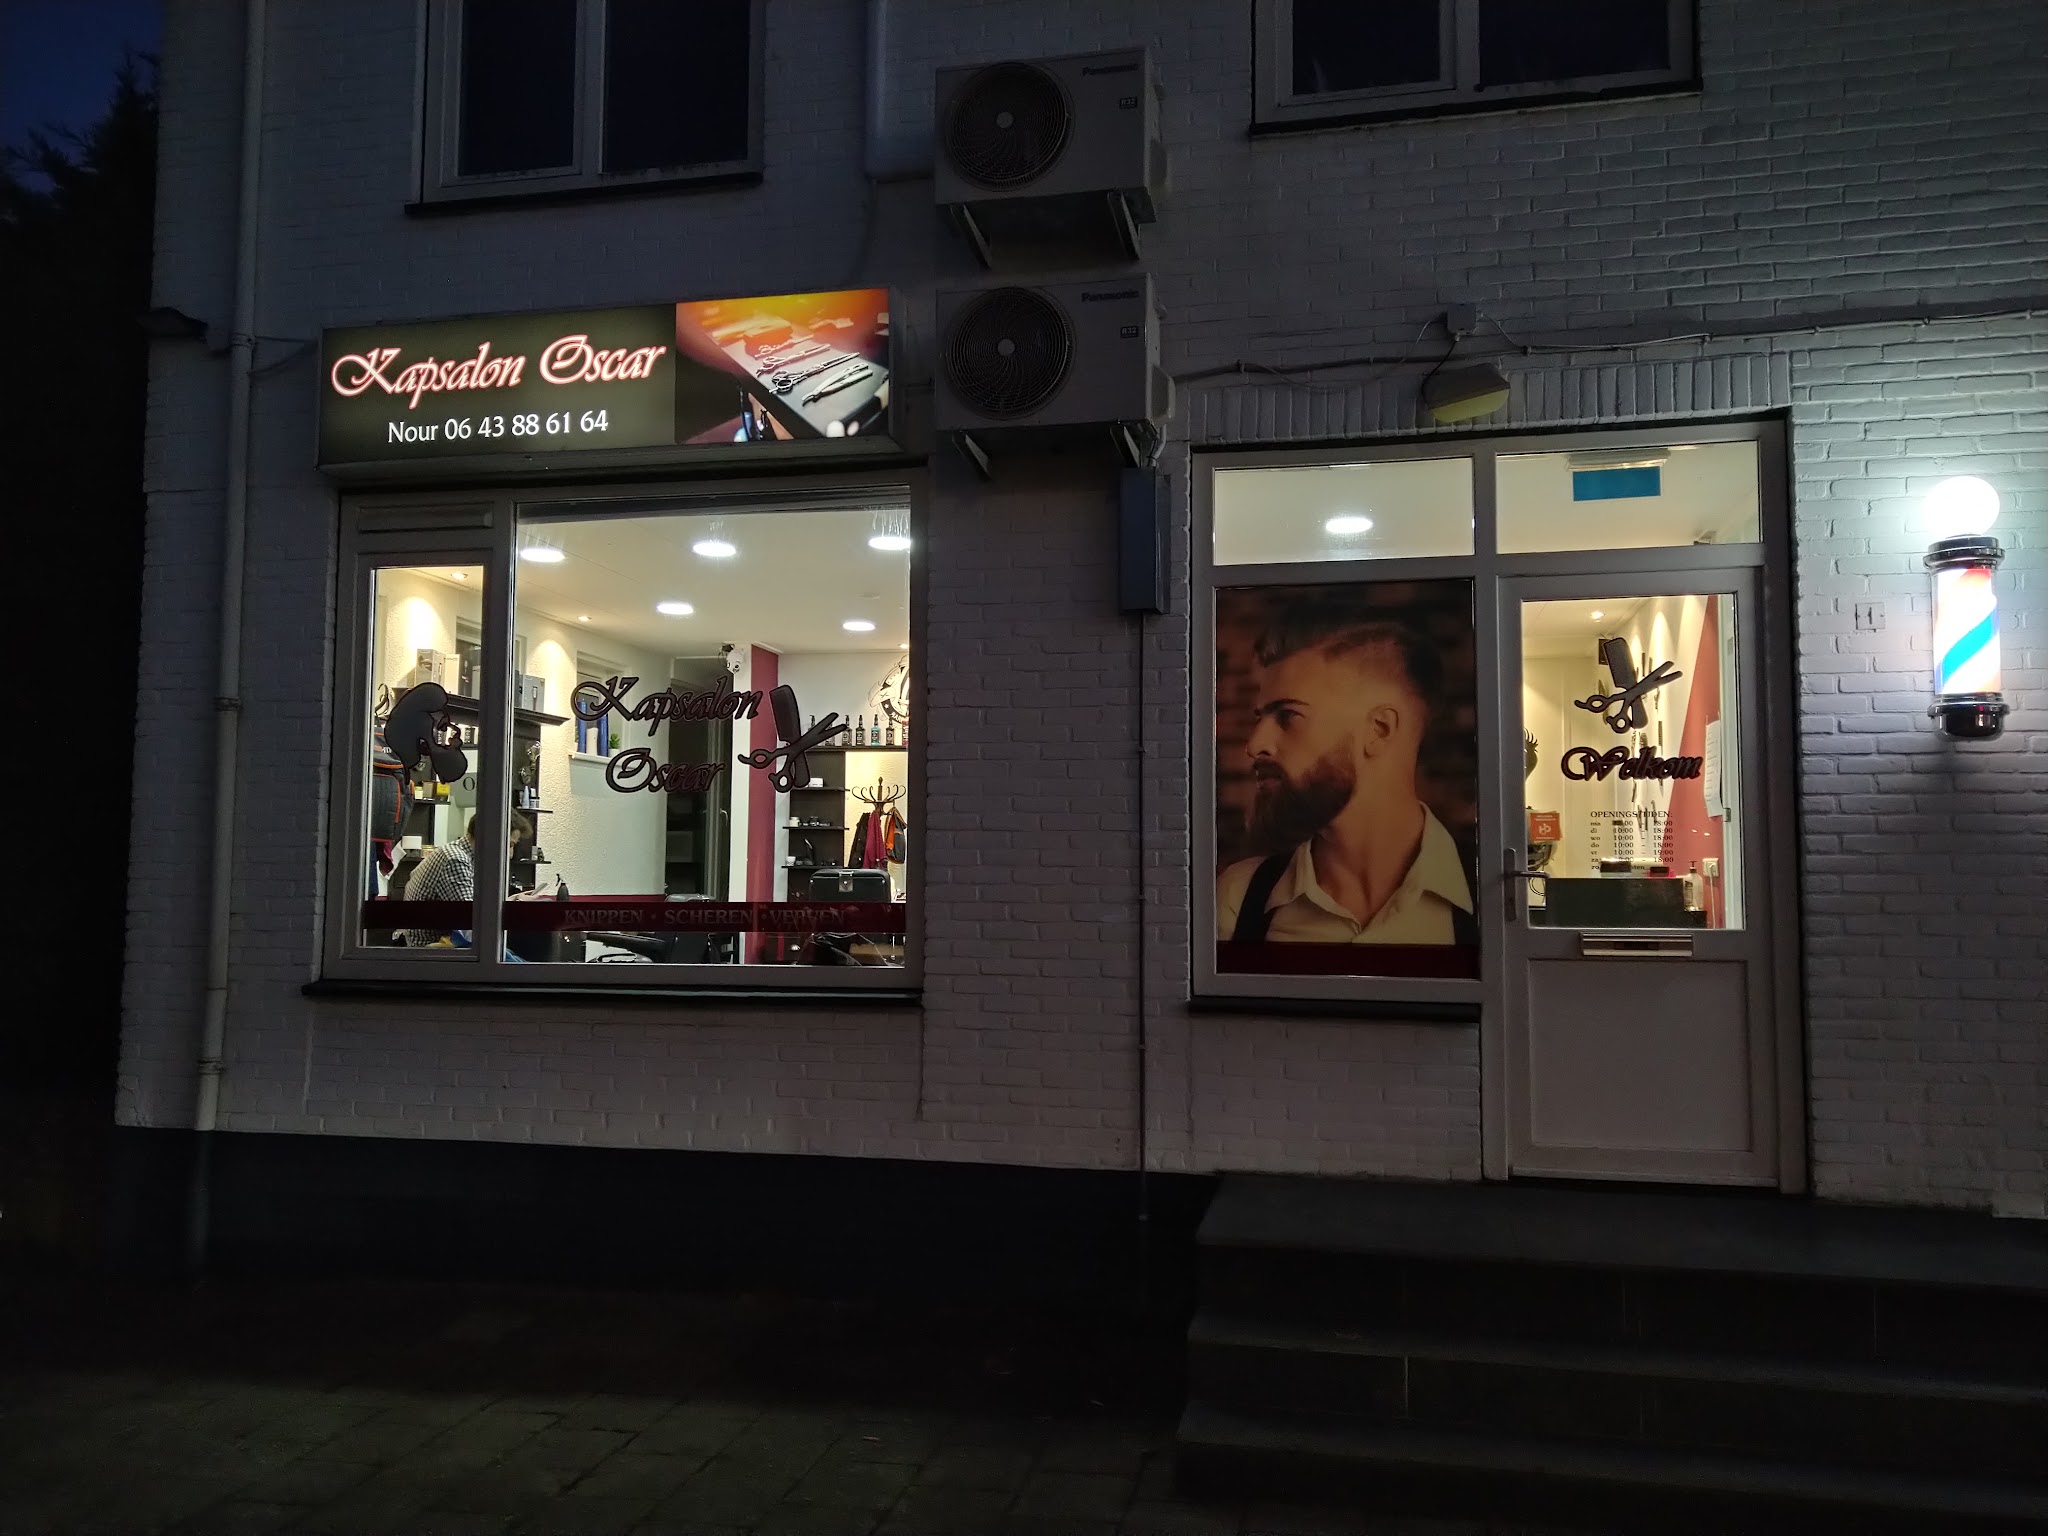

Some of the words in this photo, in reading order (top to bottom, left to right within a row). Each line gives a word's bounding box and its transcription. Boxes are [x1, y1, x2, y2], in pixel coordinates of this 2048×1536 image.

[331, 341, 526, 409] Kapsalon
[540, 334, 666, 385] Oscar
[387, 420, 438, 444] Nour
[444, 418, 472, 440] 06
[477, 417, 504, 438] 43
[512, 415, 540, 436] 88
[545, 412, 573, 433] 61
[580, 410, 609, 431] 64
[571, 676, 763, 737] Kapsalon
[605, 748, 726, 793] Oscar
[1561, 746, 1704, 782] Welkom
[563, 909, 643, 926] KNIPPEN
[663, 909, 753, 926] SCHEREN
